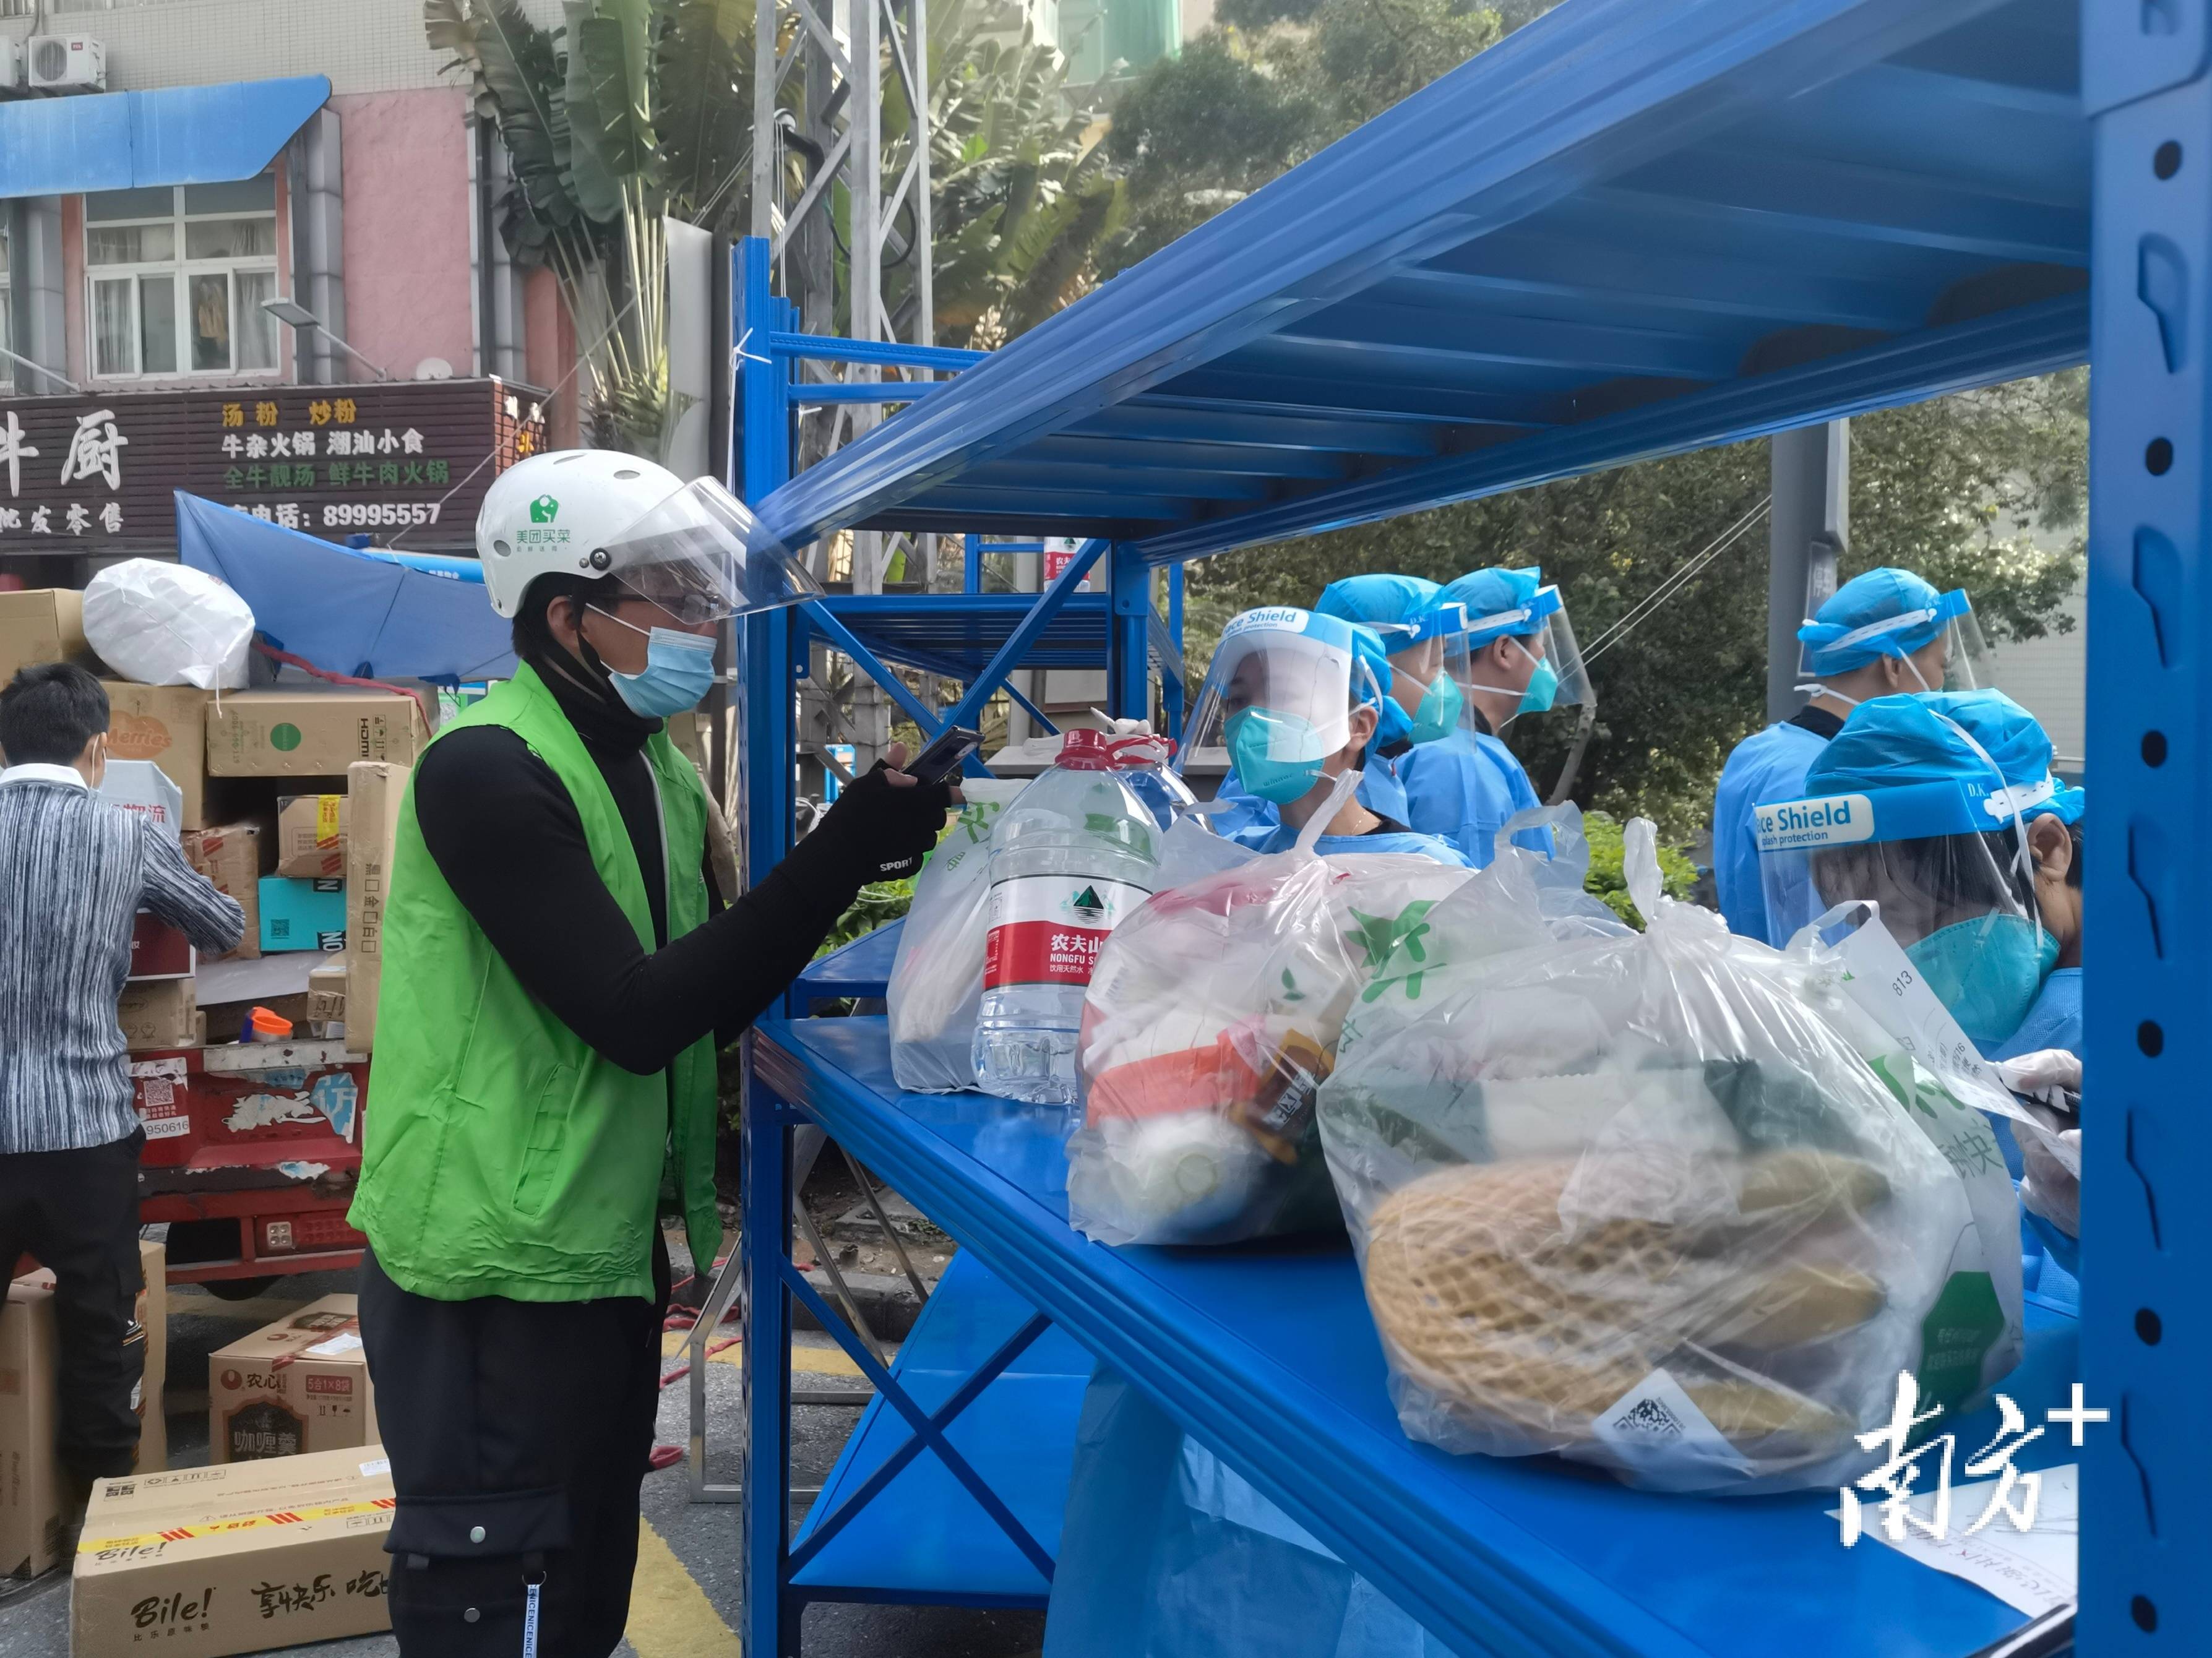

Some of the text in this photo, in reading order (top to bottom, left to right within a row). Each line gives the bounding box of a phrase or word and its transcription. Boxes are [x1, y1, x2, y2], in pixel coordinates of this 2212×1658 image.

[222, 427, 424, 459] 牛杂火锅 潮汕小食
[223, 460, 450, 489] 全牛靓汤 鲜牛肉火锅
[322, 502, 441, 526] 89995557
[516, 529, 571, 544] 美团买菜
[1224, 619, 1244, 634] ace
[1247, 610, 1297, 624] Shield
[1967, 783, 1989, 797] D.K.
[1757, 801, 1851, 834] ace Shield
[1779, 831, 1828, 846] protection
[880, 856, 913, 872] SPORT
[1049, 964, 1083, 974] 饮用天然水
[1050, 953, 1085, 964] NONGFU
[1892, 970, 1913, 997] 813
[94, 1542, 168, 1561] Bile!
[131, 1587, 213, 1628] Bile!
